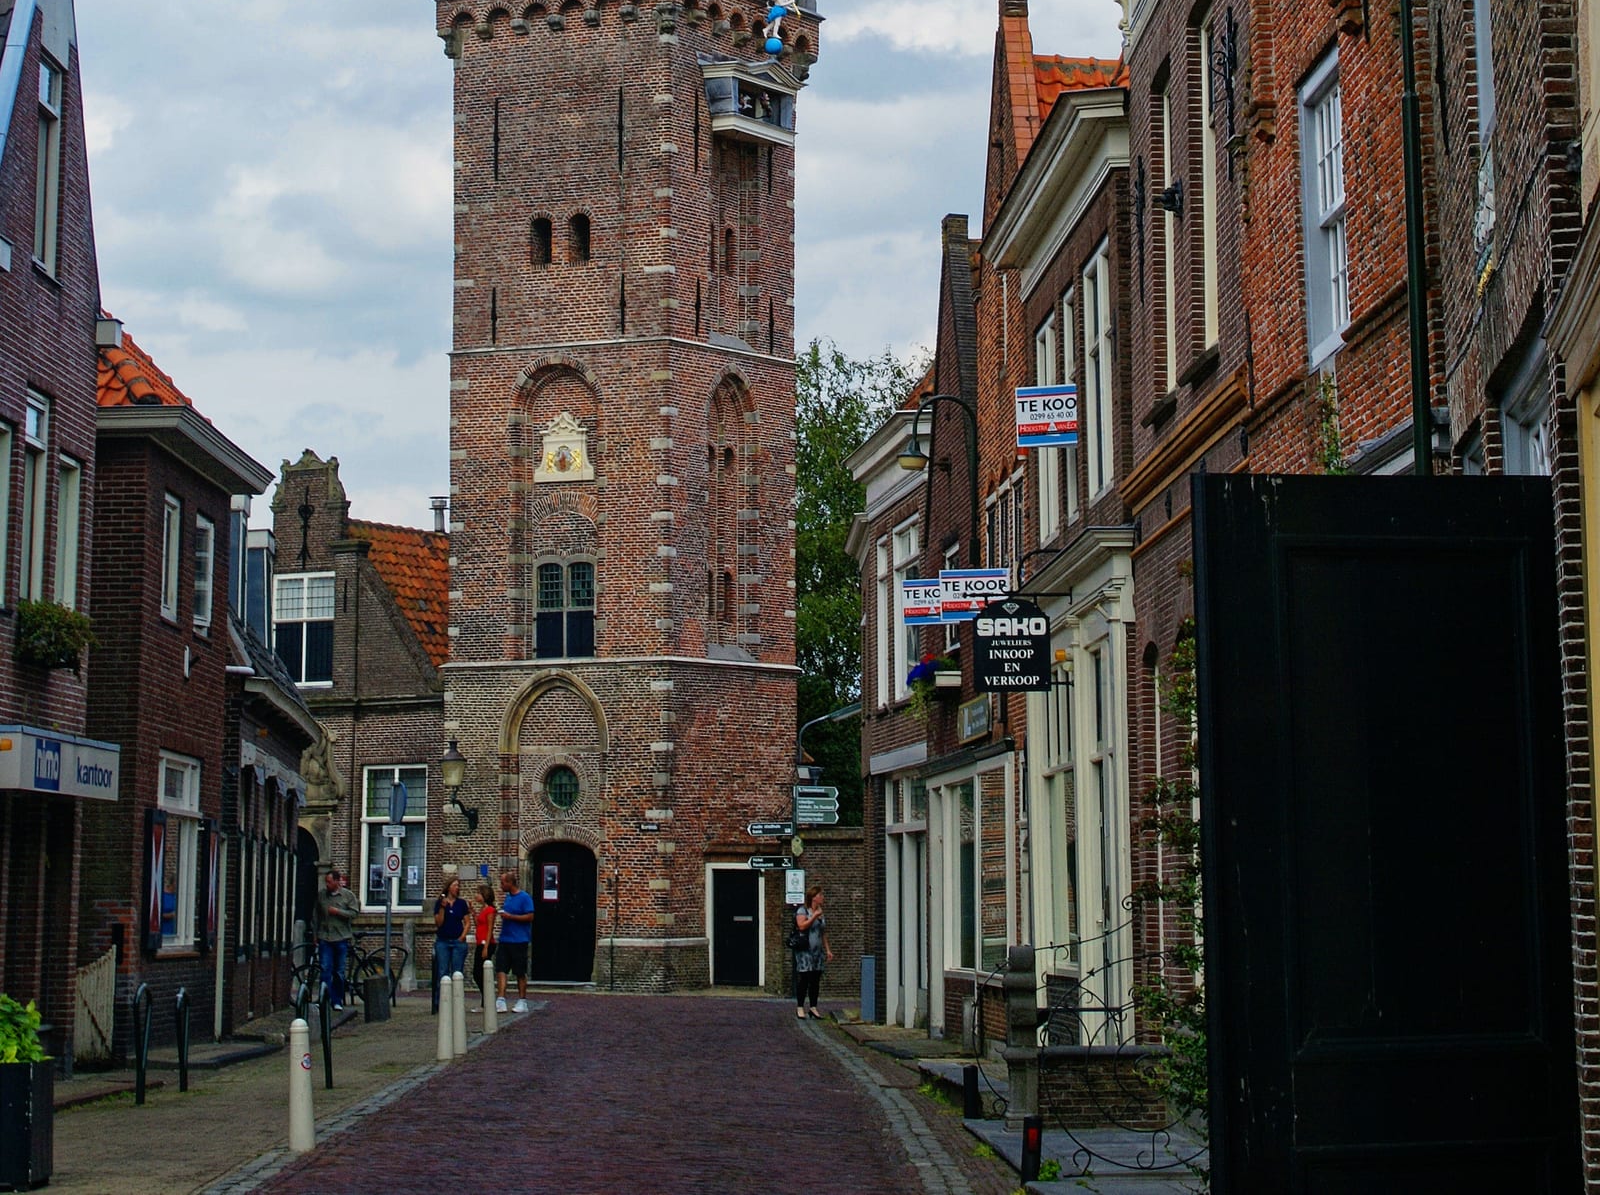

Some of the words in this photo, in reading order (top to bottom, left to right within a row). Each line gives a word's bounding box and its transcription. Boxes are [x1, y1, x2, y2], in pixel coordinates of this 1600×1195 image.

[1018, 399, 1038, 412] TE
[1042, 397, 1077, 411] KOO
[1029, 413, 1046, 421] 0299
[1047, 412, 1055, 420] 65
[1056, 411, 1065, 419] 40
[1065, 410, 1074, 418] 00
[941, 581, 961, 591] TE
[965, 580, 1007, 591] KOOP
[904, 589, 920, 599] TE
[924, 588, 940, 598] KO
[976, 617, 1047, 636] SAKO
[989, 649, 1034, 659] INKOOP
[1004, 662, 1020, 672] EN
[984, 675, 1040, 686] VERKOOP
[77, 756, 112, 788] kantoor
